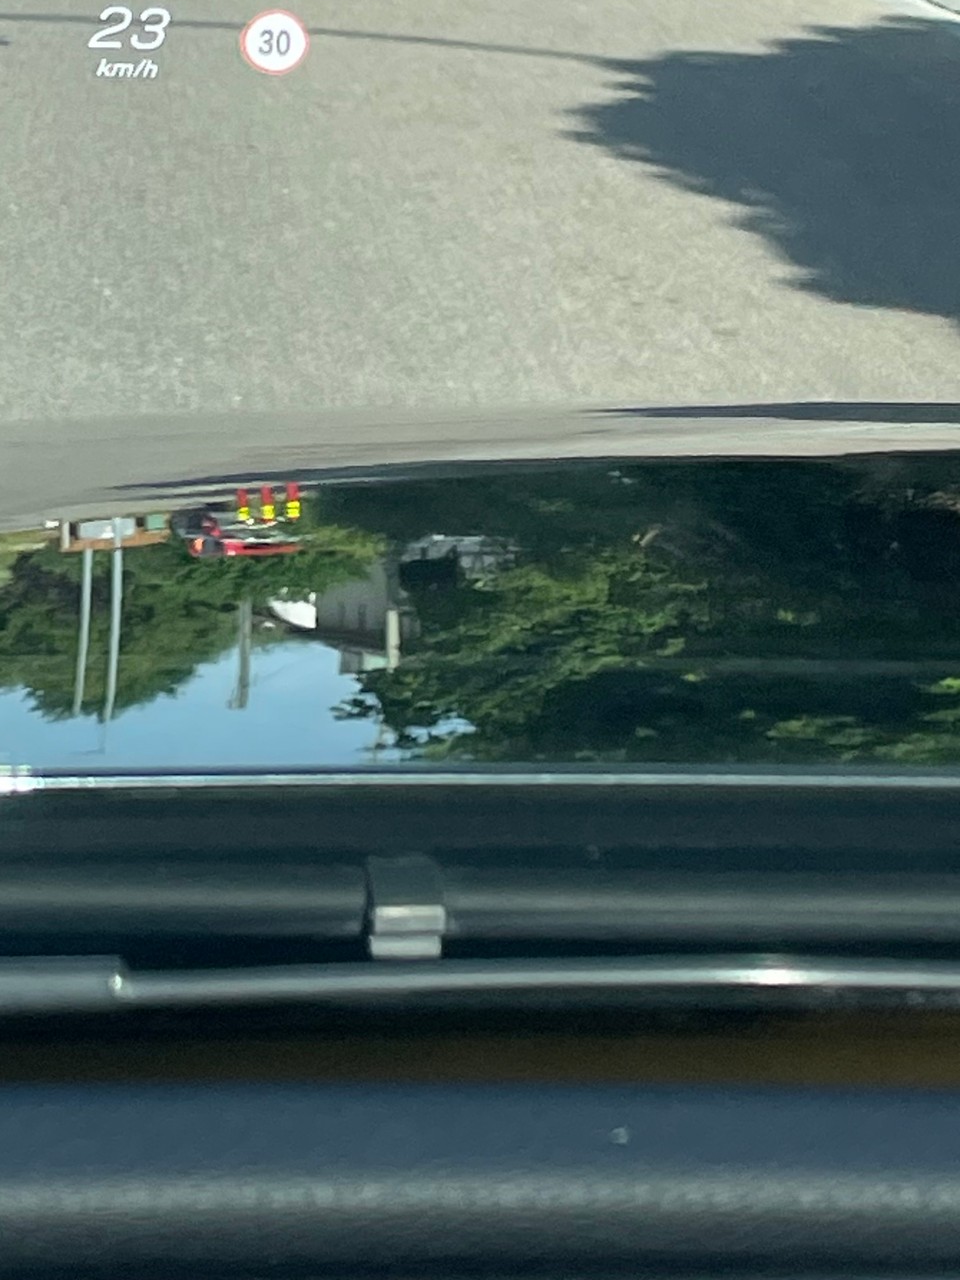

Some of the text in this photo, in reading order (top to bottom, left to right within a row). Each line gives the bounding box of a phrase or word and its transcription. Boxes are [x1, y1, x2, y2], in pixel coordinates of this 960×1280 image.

[88, 6, 171, 50] 23
[258, 29, 291, 55] 30
[96, 58, 158, 79] km/h
